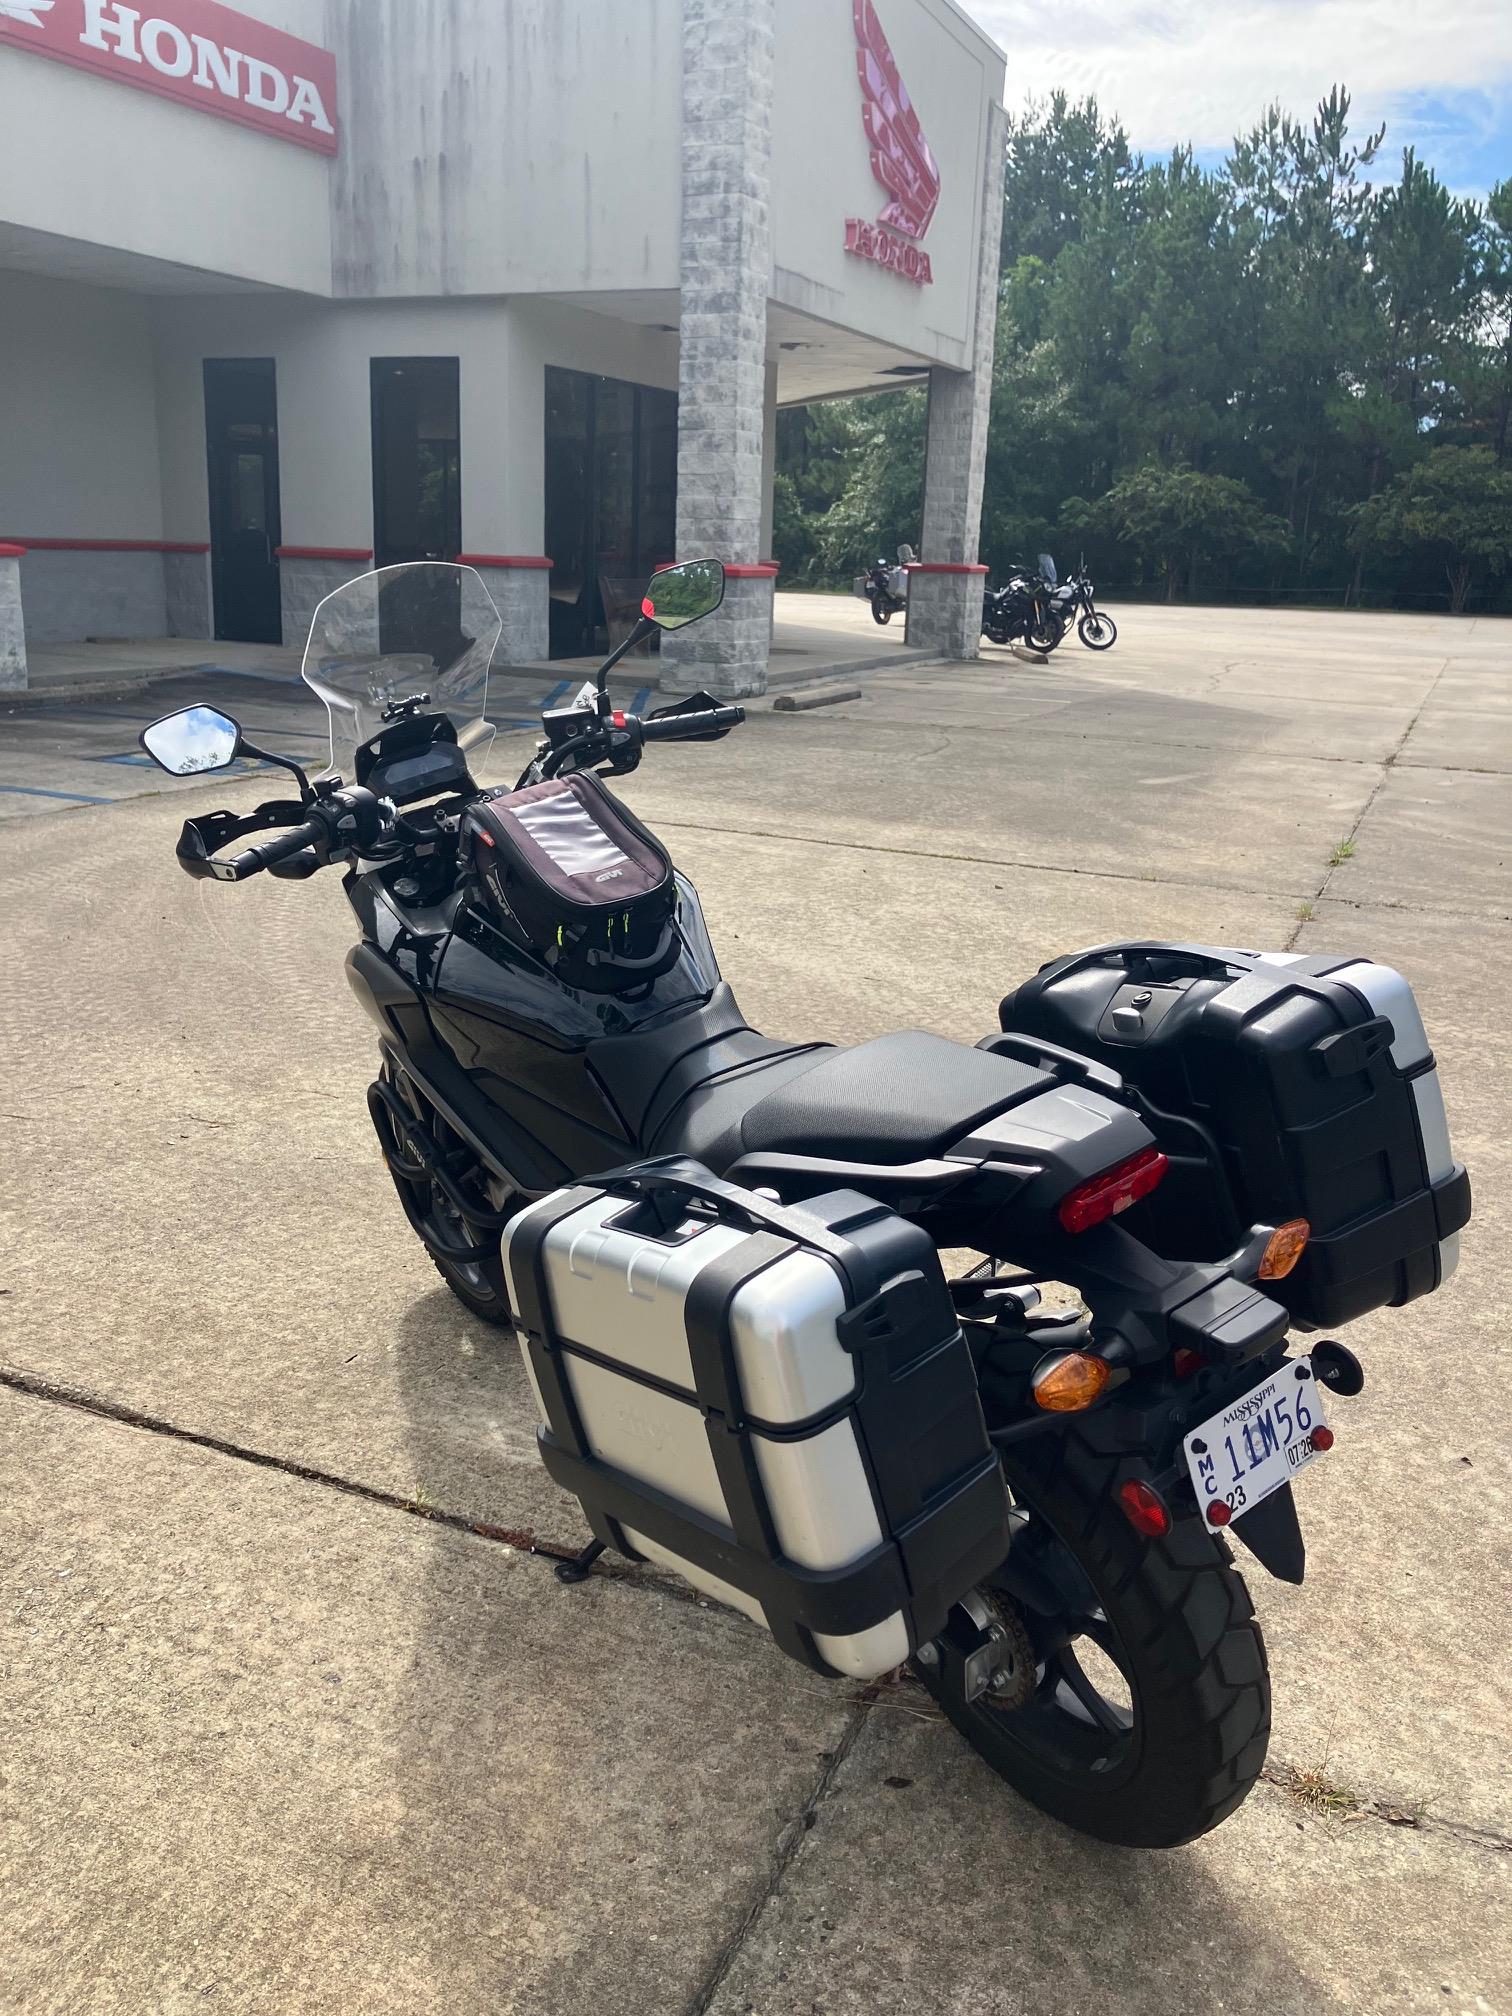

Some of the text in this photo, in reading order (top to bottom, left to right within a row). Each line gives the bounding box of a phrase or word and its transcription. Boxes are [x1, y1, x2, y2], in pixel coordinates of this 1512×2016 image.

[79, 0, 335, 135] HONDA
[844, 218, 934, 287] HONDA
[1223, 1383, 1276, 1428] MISSISSIPPI
[1225, 1386, 1312, 1483] 11M56
[1225, 1484, 1248, 1514] 23
